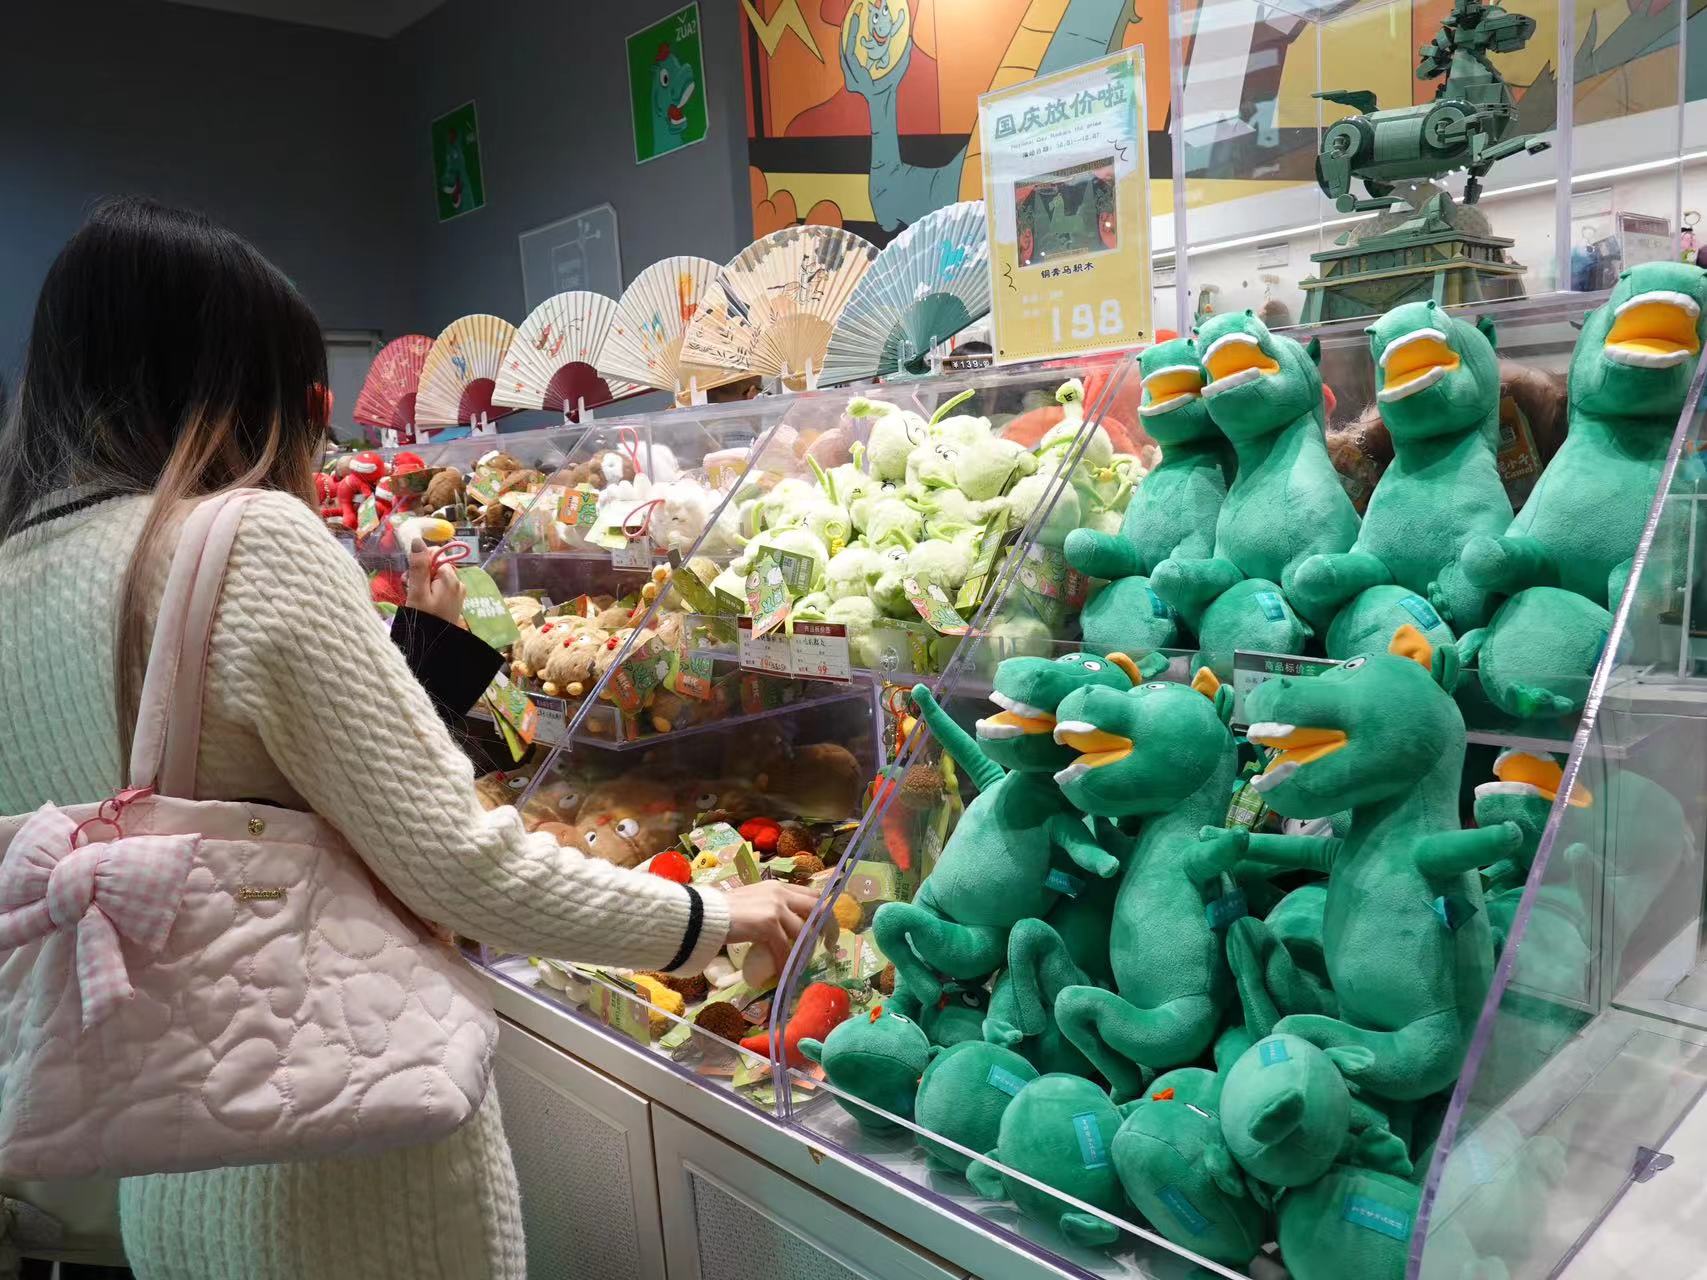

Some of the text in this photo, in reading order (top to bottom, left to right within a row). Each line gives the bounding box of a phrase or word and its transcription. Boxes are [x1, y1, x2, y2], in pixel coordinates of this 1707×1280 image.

[994, 80, 1128, 139] 国庆放价啦
[1041, 262, 1094, 278] 铜奔马积木
[1051, 298, 1124, 345] 198
